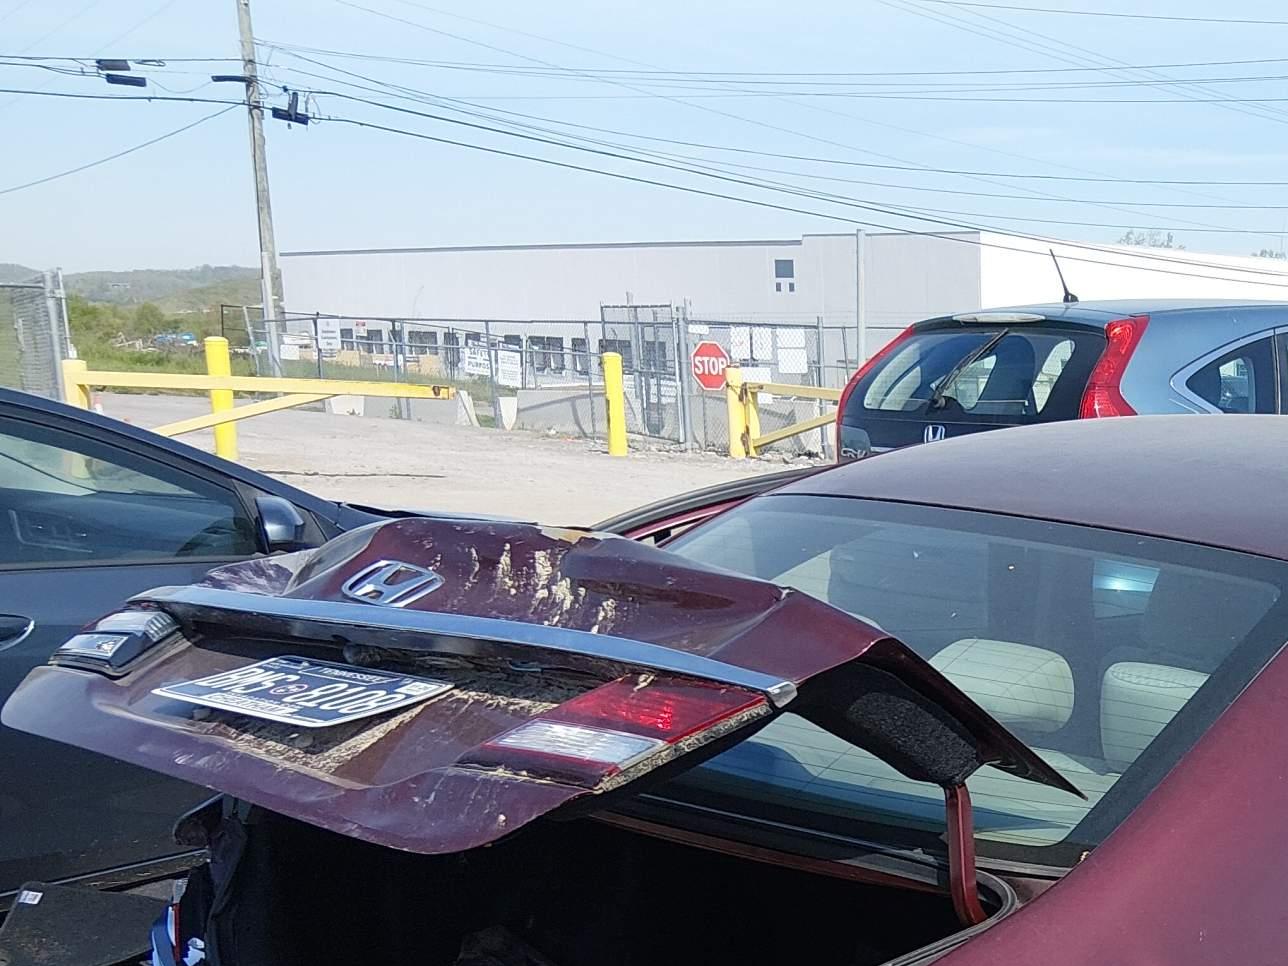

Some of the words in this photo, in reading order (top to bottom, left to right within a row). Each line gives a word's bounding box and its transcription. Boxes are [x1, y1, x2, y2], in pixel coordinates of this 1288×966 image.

[694, 356, 727, 376] STOP
[321, 667, 390, 682] TENNESSEE
[282, 683, 406, 713] 8108
